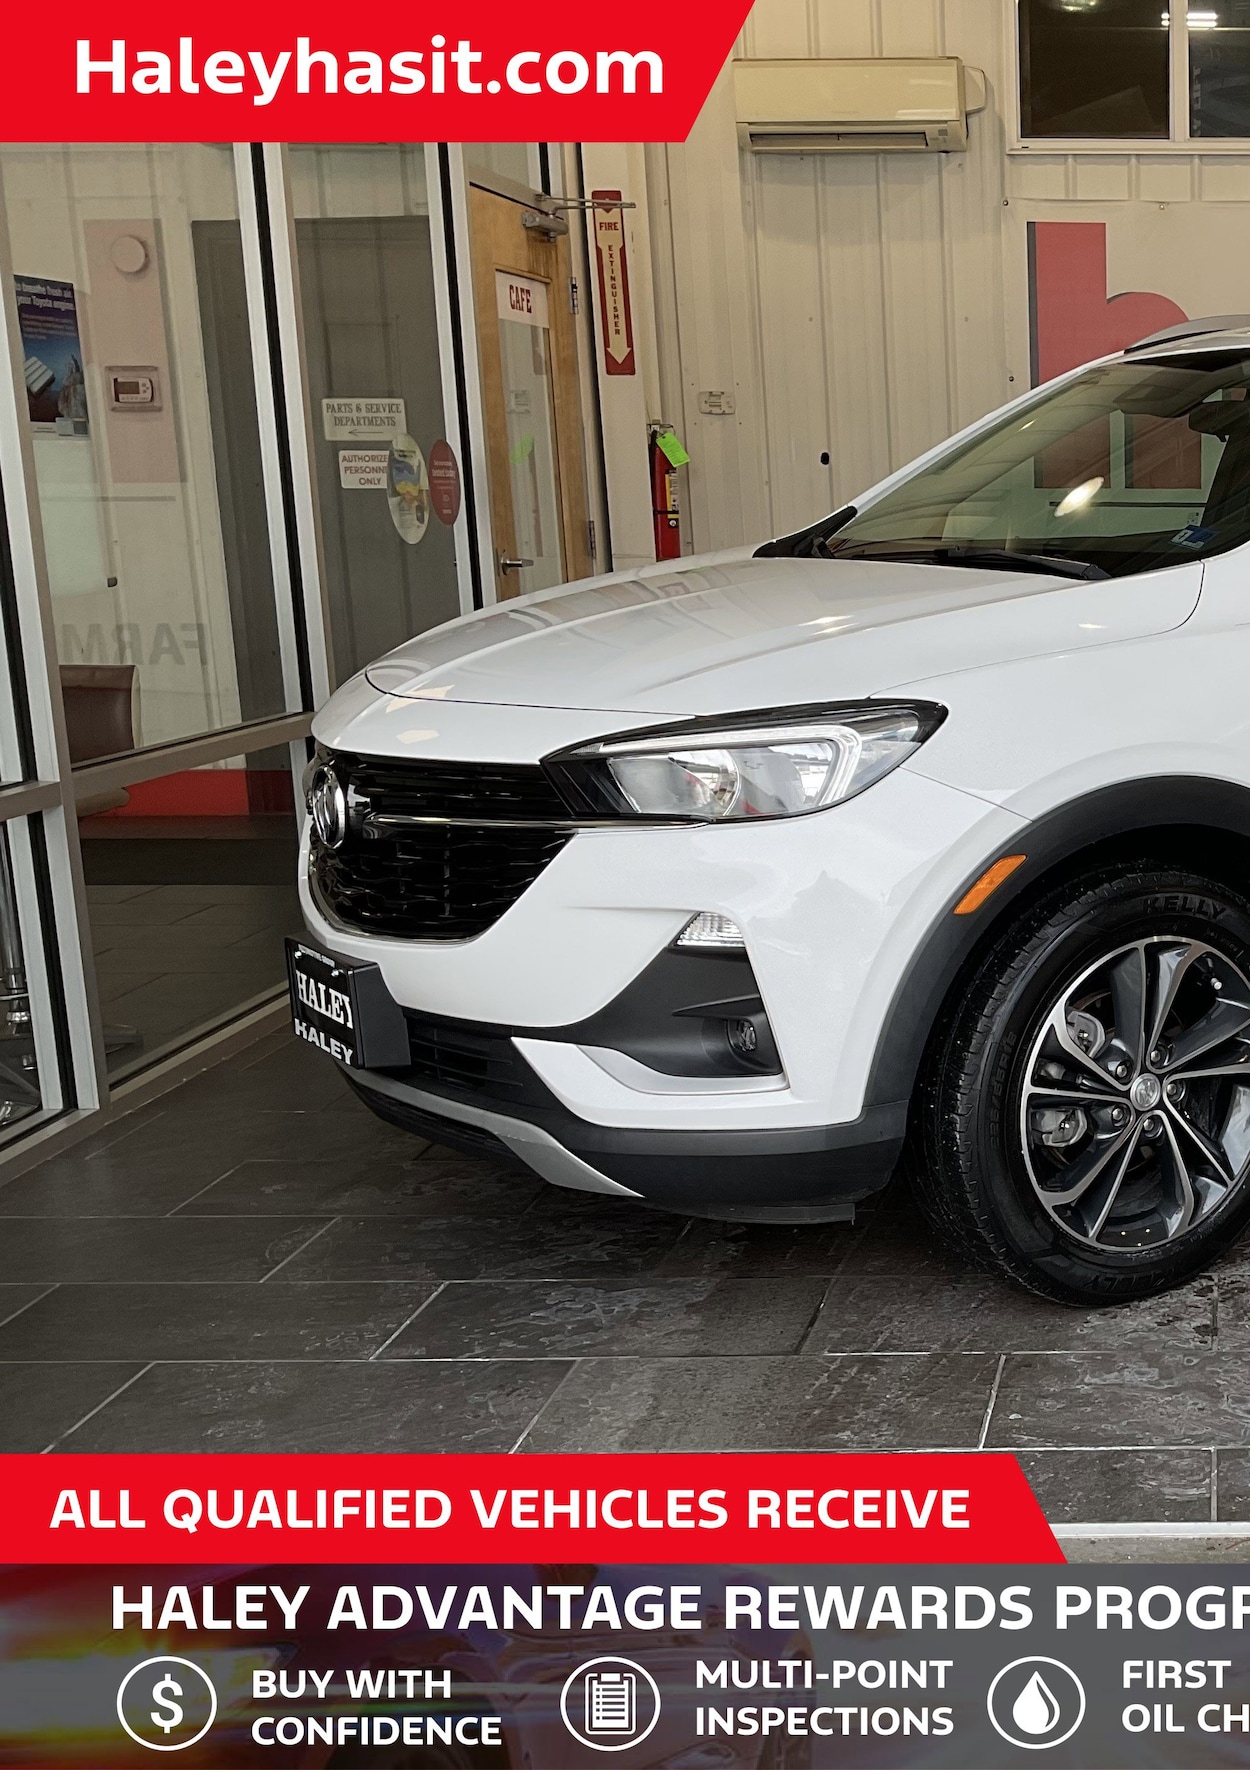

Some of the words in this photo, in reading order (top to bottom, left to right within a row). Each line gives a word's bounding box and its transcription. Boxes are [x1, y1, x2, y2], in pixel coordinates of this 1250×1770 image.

[599, 222, 619, 231] FIRE
[608, 244, 621, 335] EXTINGUISHER
[509, 284, 532, 314] CAFE
[326, 403, 353, 414] PARTS
[355, 403, 362, 413] &
[365, 403, 402, 414] SERVICE
[334, 416, 396, 427] DEPARTMENTS
[341, 454, 388, 463] AUTHORIZE
[344, 466, 388, 474] PERSONN
[358, 477, 382, 485] ONLY
[1143, 894, 1227, 920] KELLY
[295, 969, 353, 1029] HALEY
[295, 1018, 353, 1065] HALEY
